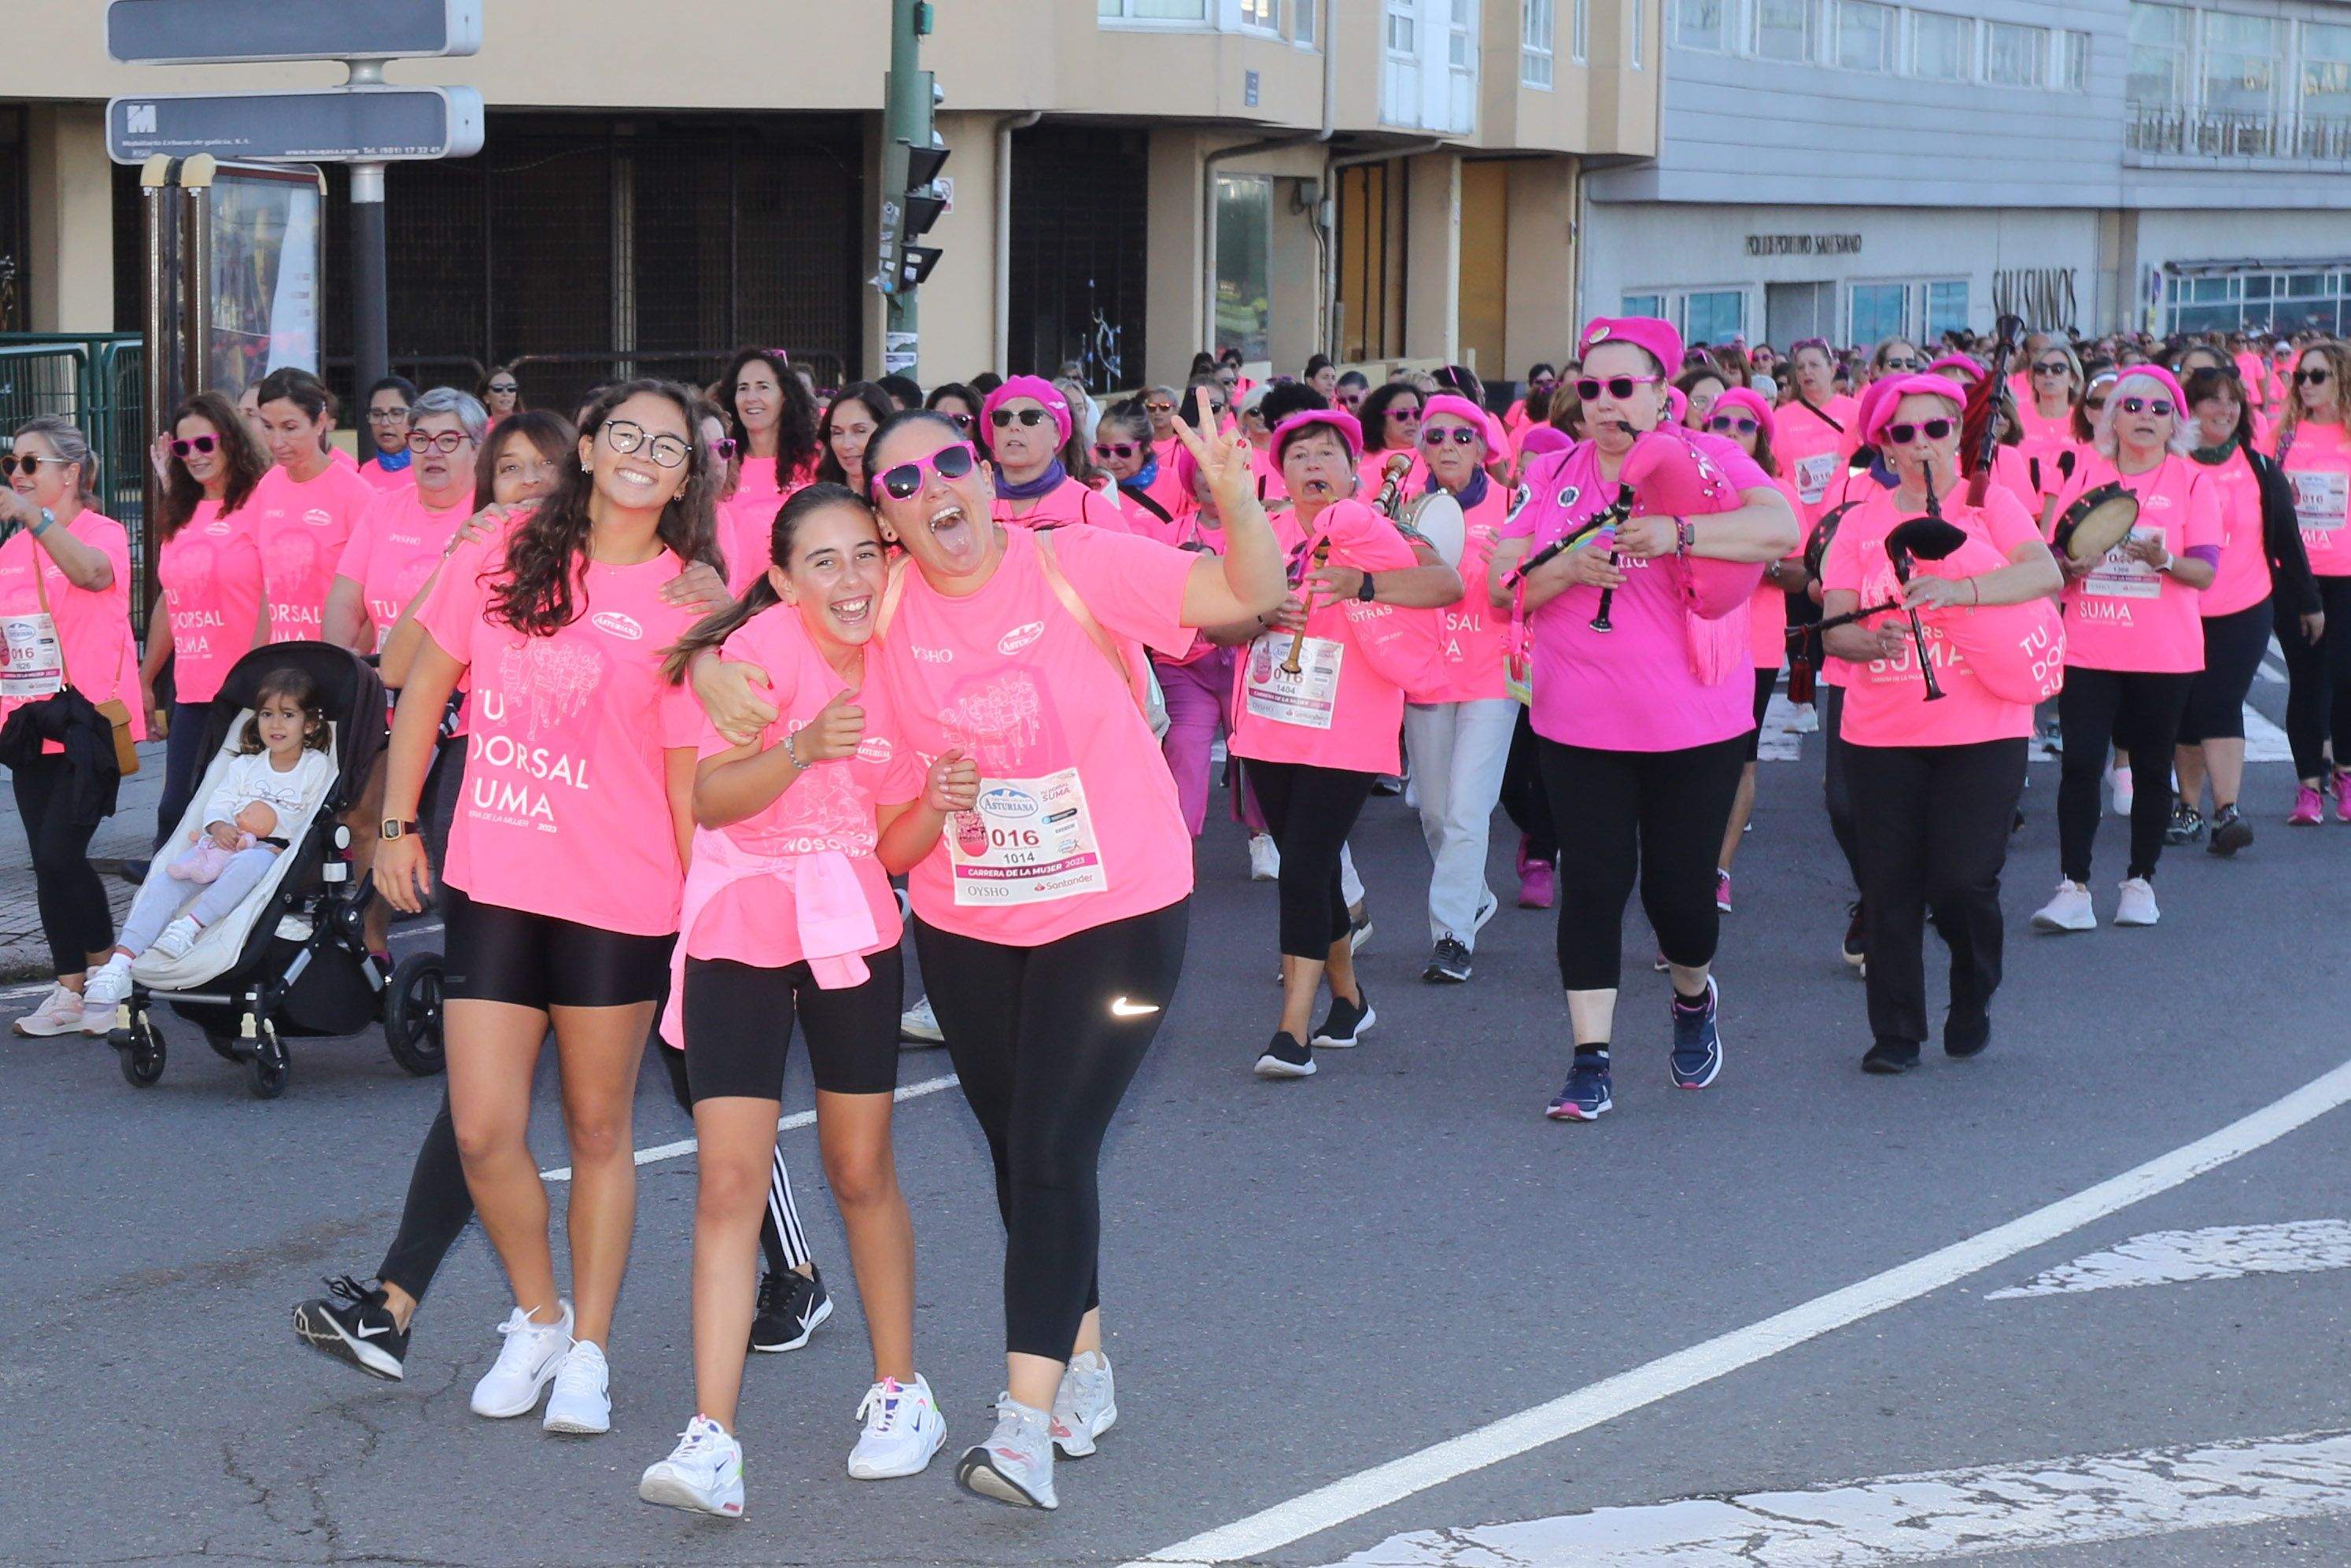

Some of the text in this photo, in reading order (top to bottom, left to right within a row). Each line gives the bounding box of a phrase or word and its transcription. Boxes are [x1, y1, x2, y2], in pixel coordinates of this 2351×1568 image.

[268, 603, 322, 624] ORSAL
[371, 600, 397, 618] TU
[2080, 601, 2132, 621] SUMA
[1446, 612, 1482, 633] SAL
[2018, 625, 2048, 659] TU
[11, 647, 35, 659] 016
[911, 645, 953, 663] YSHO
[478, 688, 504, 720] U
[474, 777, 554, 821] UMA
[1042, 787, 1071, 802] SUMA
[984, 797, 1035, 812] ASTURIANA
[537, 822, 558, 833] 2023
[991, 828, 1039, 847] 016
[1003, 851, 1035, 864] 1014
[967, 857, 1087, 878] CARRERA DE LA MUJER 2023
[1046, 873, 1094, 891] Santander
[967, 885, 1010, 898] OYSHO
